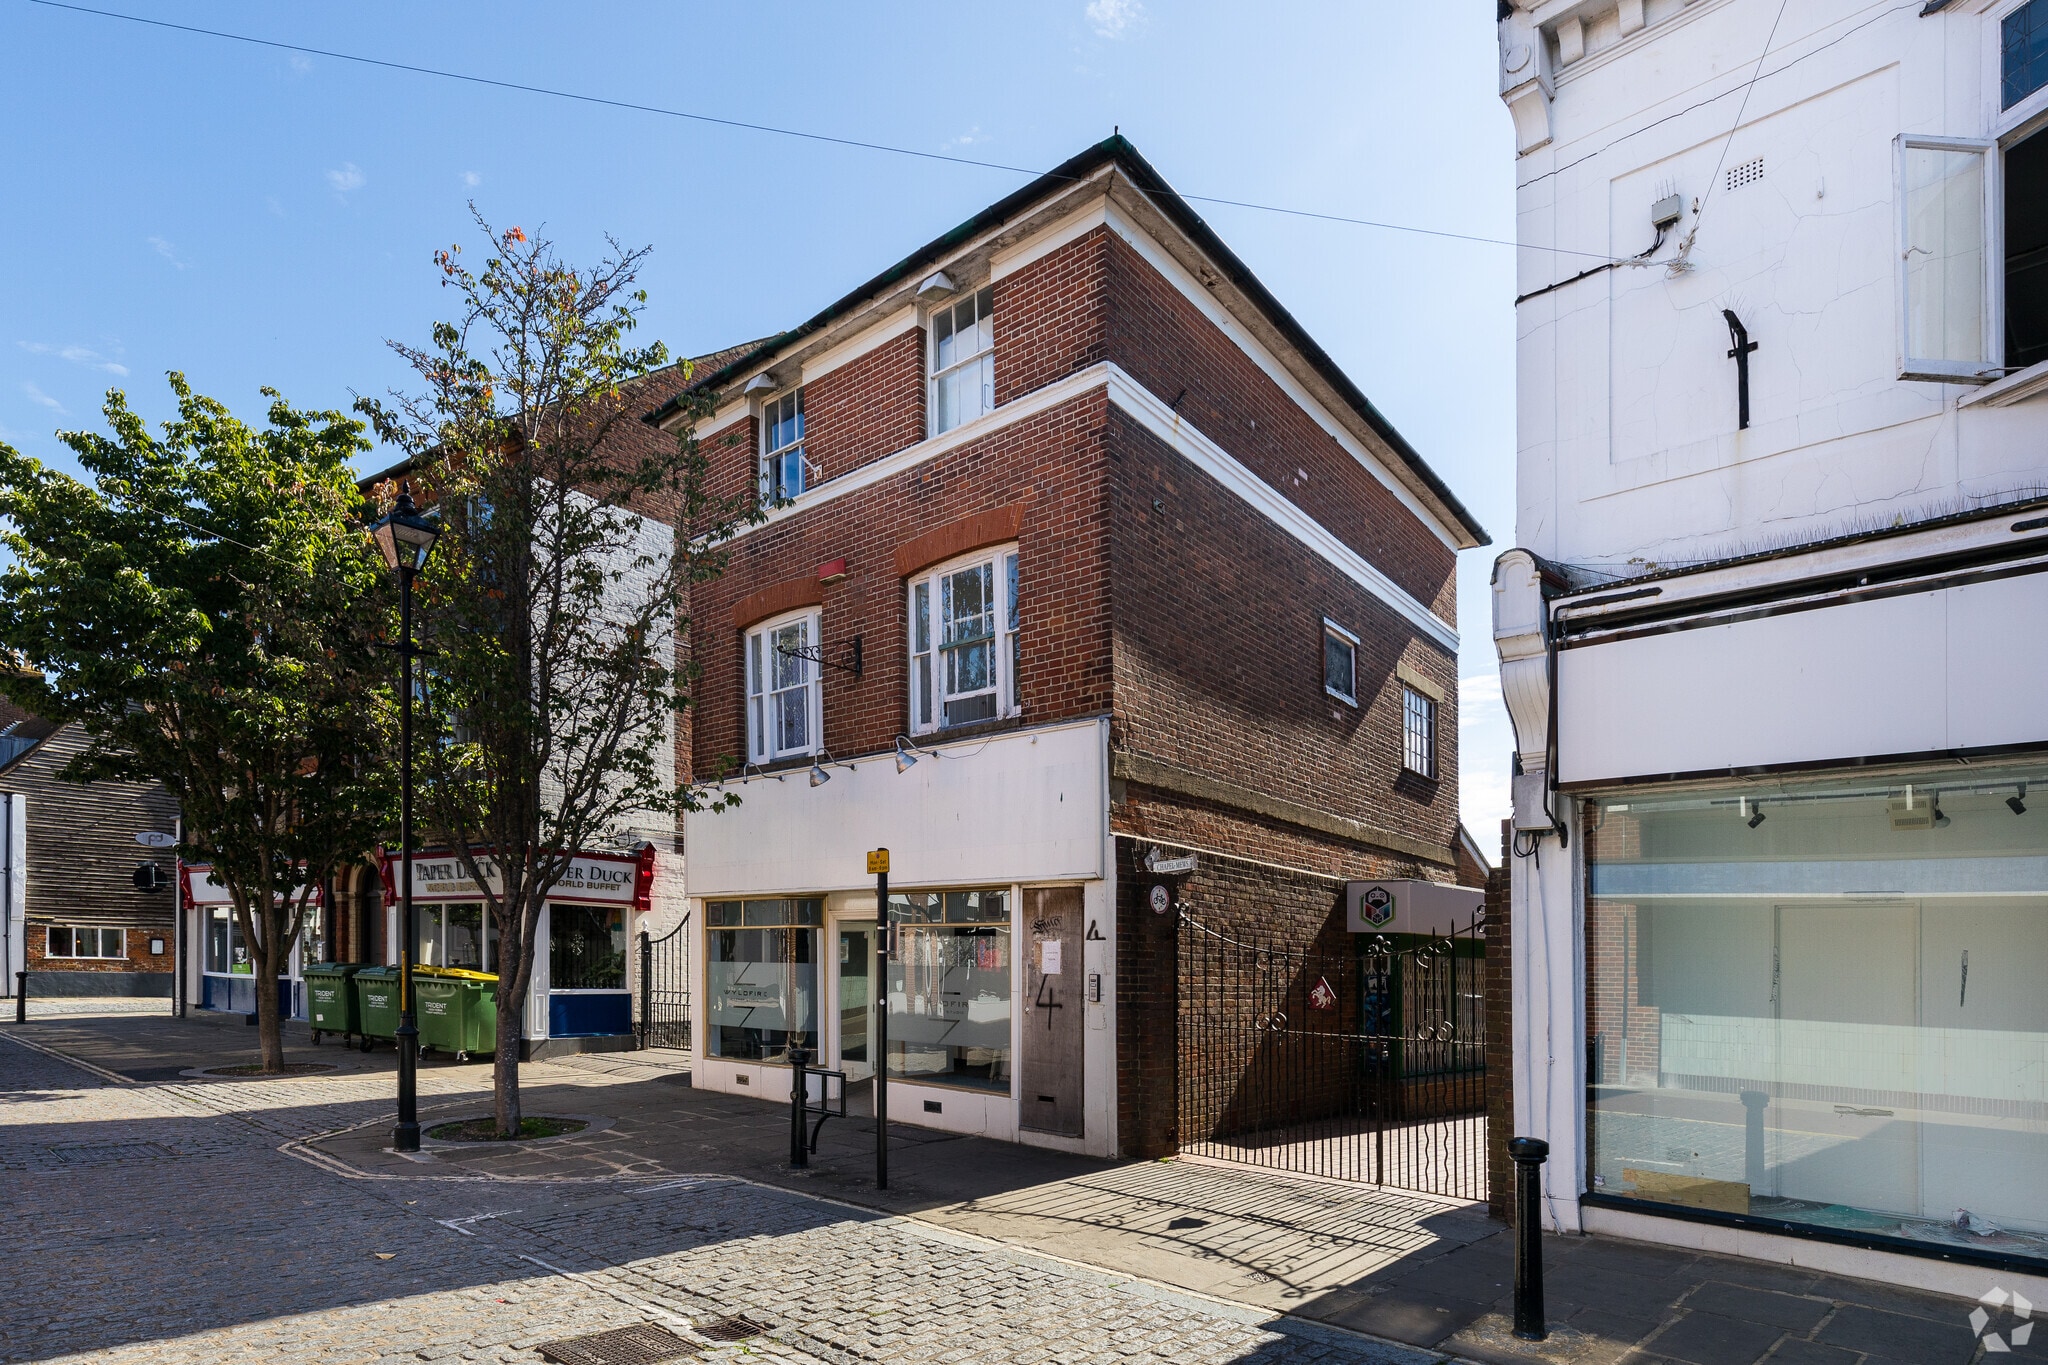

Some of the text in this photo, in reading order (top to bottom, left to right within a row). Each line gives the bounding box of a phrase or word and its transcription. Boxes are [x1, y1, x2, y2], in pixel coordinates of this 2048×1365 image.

[415, 863, 454, 881] PAPER
[590, 866, 632, 884] DUCK
[555, 879, 621, 891] ORLD BUFFET
[367, 994, 388, 1002] TRIDENT
[425, 1001, 447, 1009] TRIDENT
[1036, 974, 1063, 1031] 4
